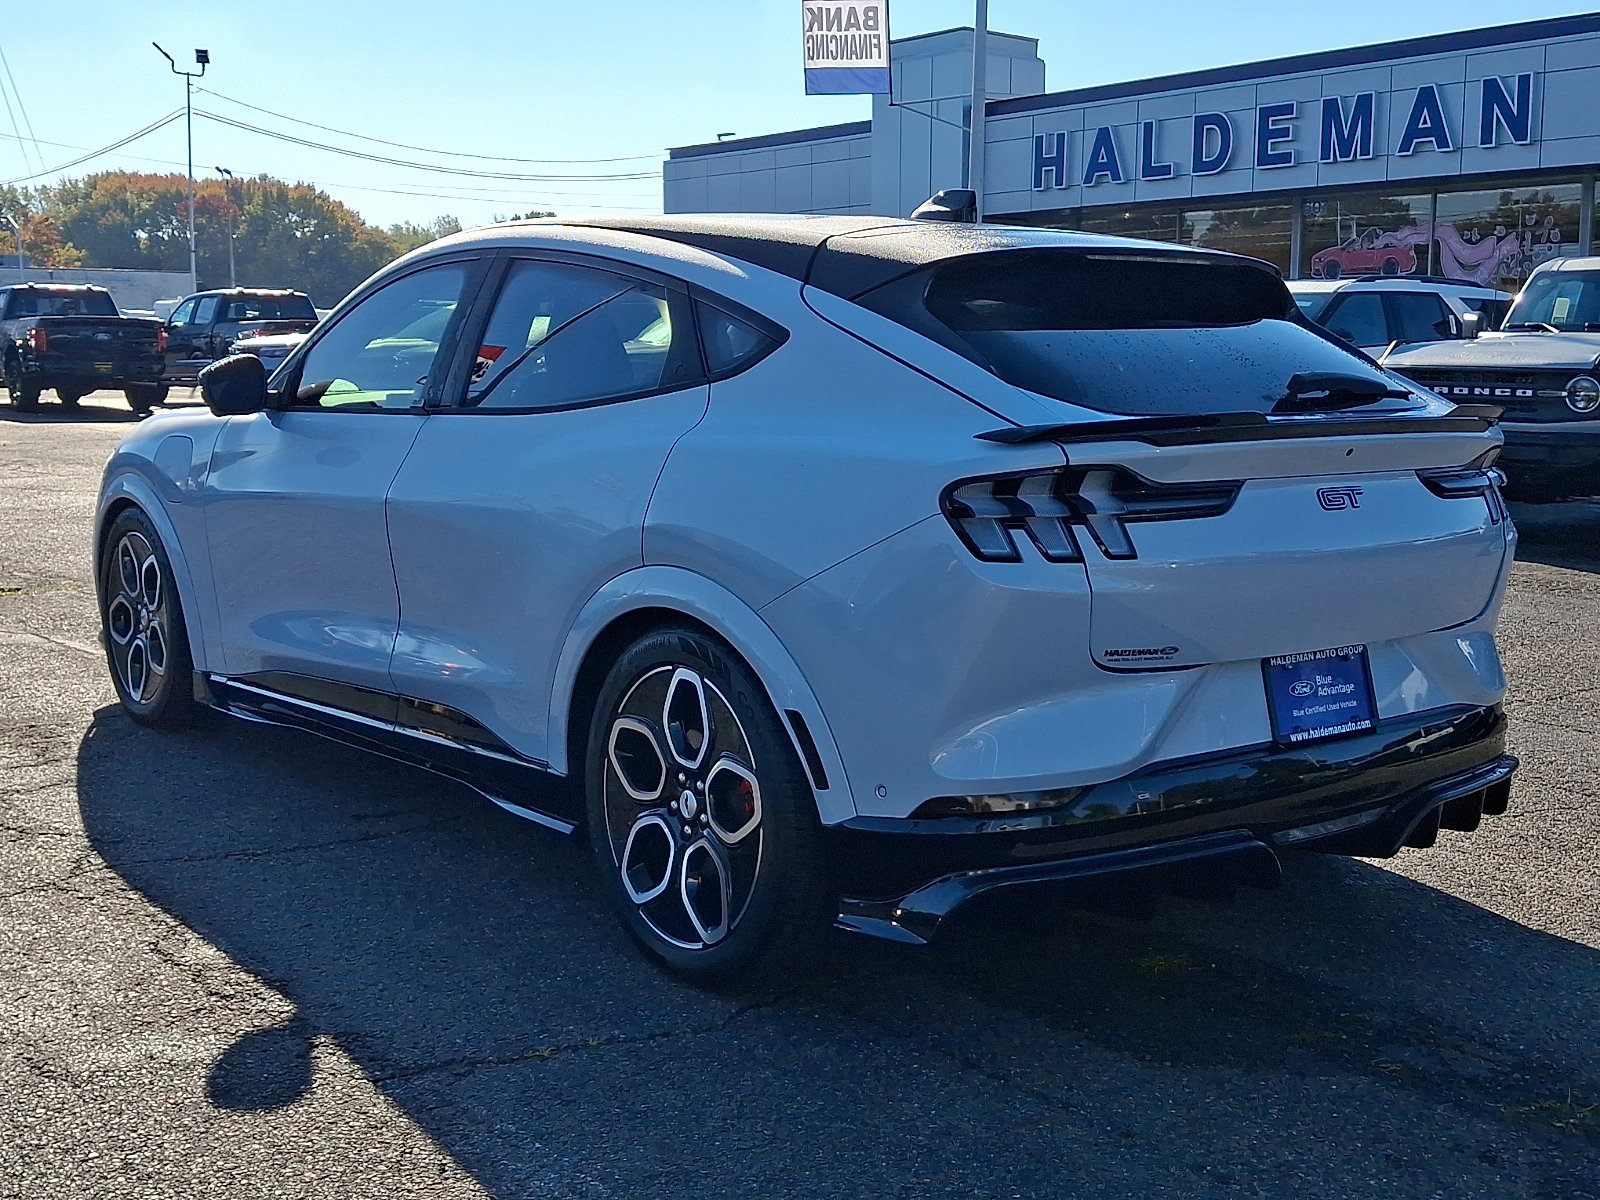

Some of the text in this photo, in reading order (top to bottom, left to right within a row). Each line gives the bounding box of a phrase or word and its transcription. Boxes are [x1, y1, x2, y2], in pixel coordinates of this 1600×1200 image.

[1032, 72, 1534, 191] HALDEMAN
[1316, 485, 1364, 511] GT
[1270, 644, 1364, 666] HALDEMAN AUTO GROUP
[1315, 675, 1332, 686] Blue
[1317, 683, 1355, 697] Advantage
[1292, 700, 1358, 717] Blue Certified Used Vehicle
[1290, 719, 1372, 742] www.haldemanauto.com
